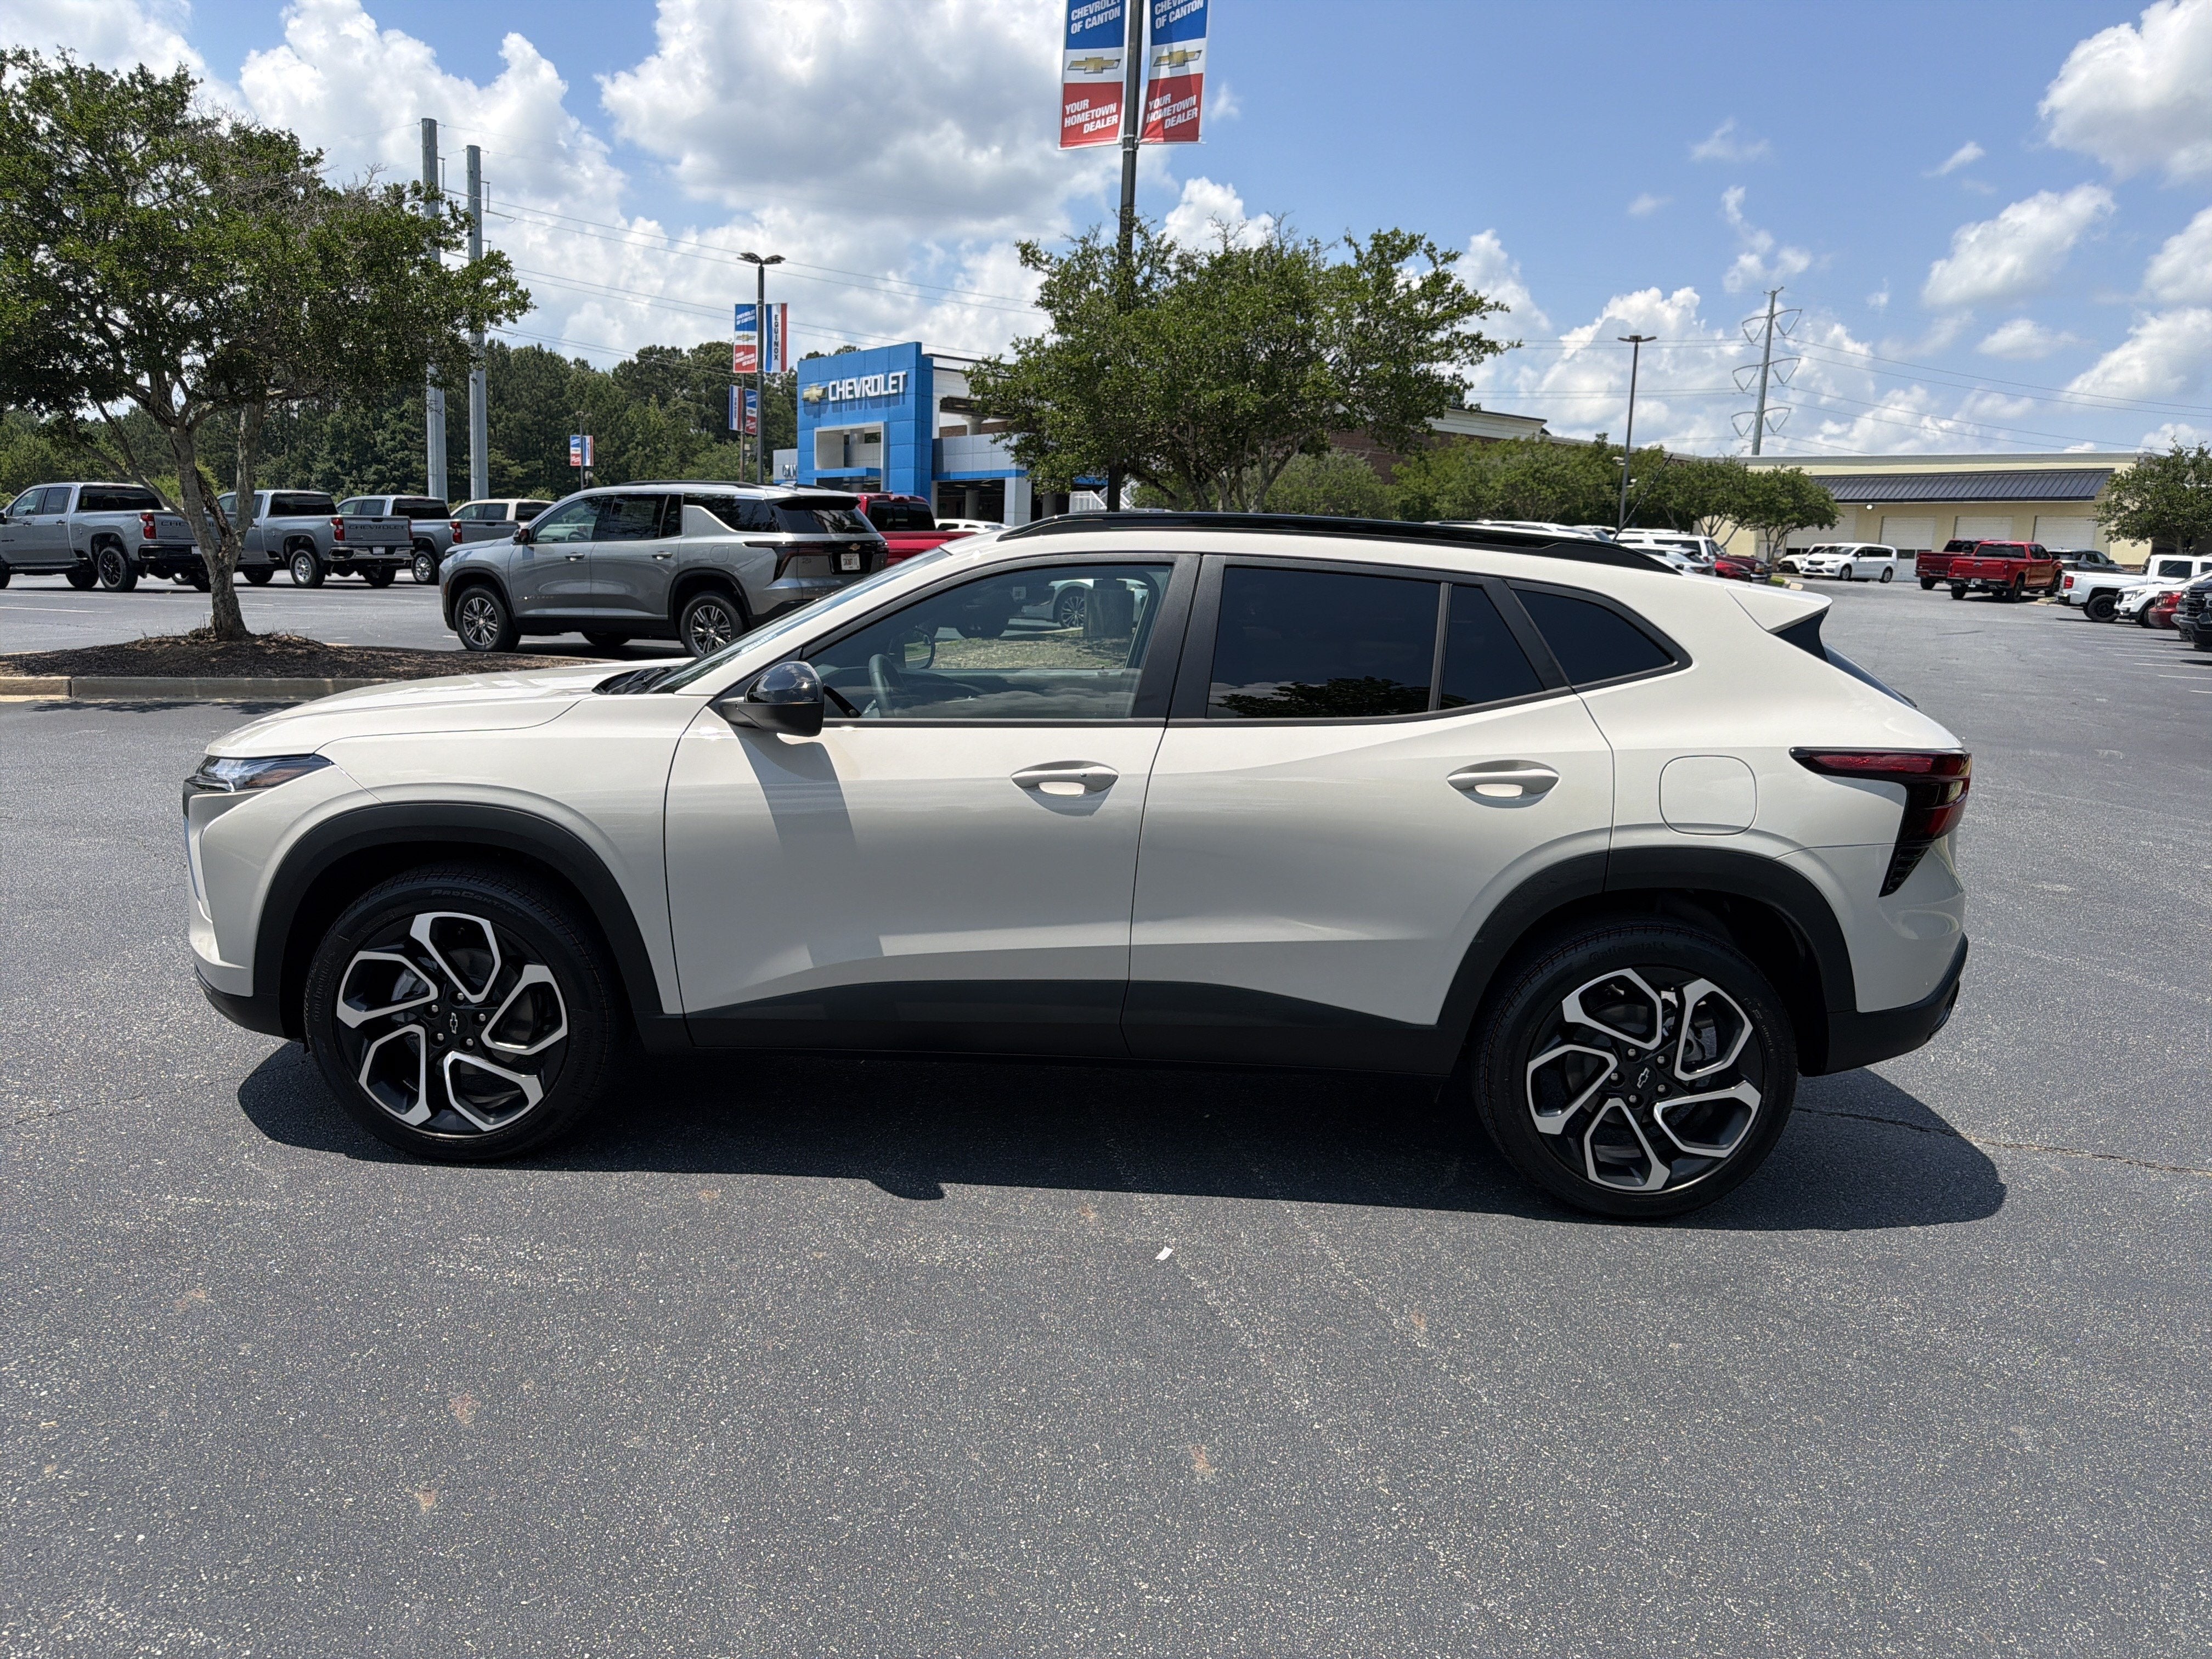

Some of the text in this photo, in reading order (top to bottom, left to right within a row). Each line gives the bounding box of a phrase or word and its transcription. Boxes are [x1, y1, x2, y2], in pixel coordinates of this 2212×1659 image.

[1071, 0, 1120, 21] CHEVROL
[1071, 5, 1121, 34] OF CANTON
[1155, 14, 1167, 29] OF
[1169, 0, 1204, 23] CANTON
[1065, 99, 1090, 115] YOUR
[1146, 94, 1197, 123] HOMETOWN
[1148, 93, 1171, 111] YOUR
[1064, 103, 1117, 127] HOMETOWN
[1082, 114, 1119, 134] DEALER
[1164, 107, 1198, 129] DEALER
[828, 371, 906, 402] CHEVROLET
